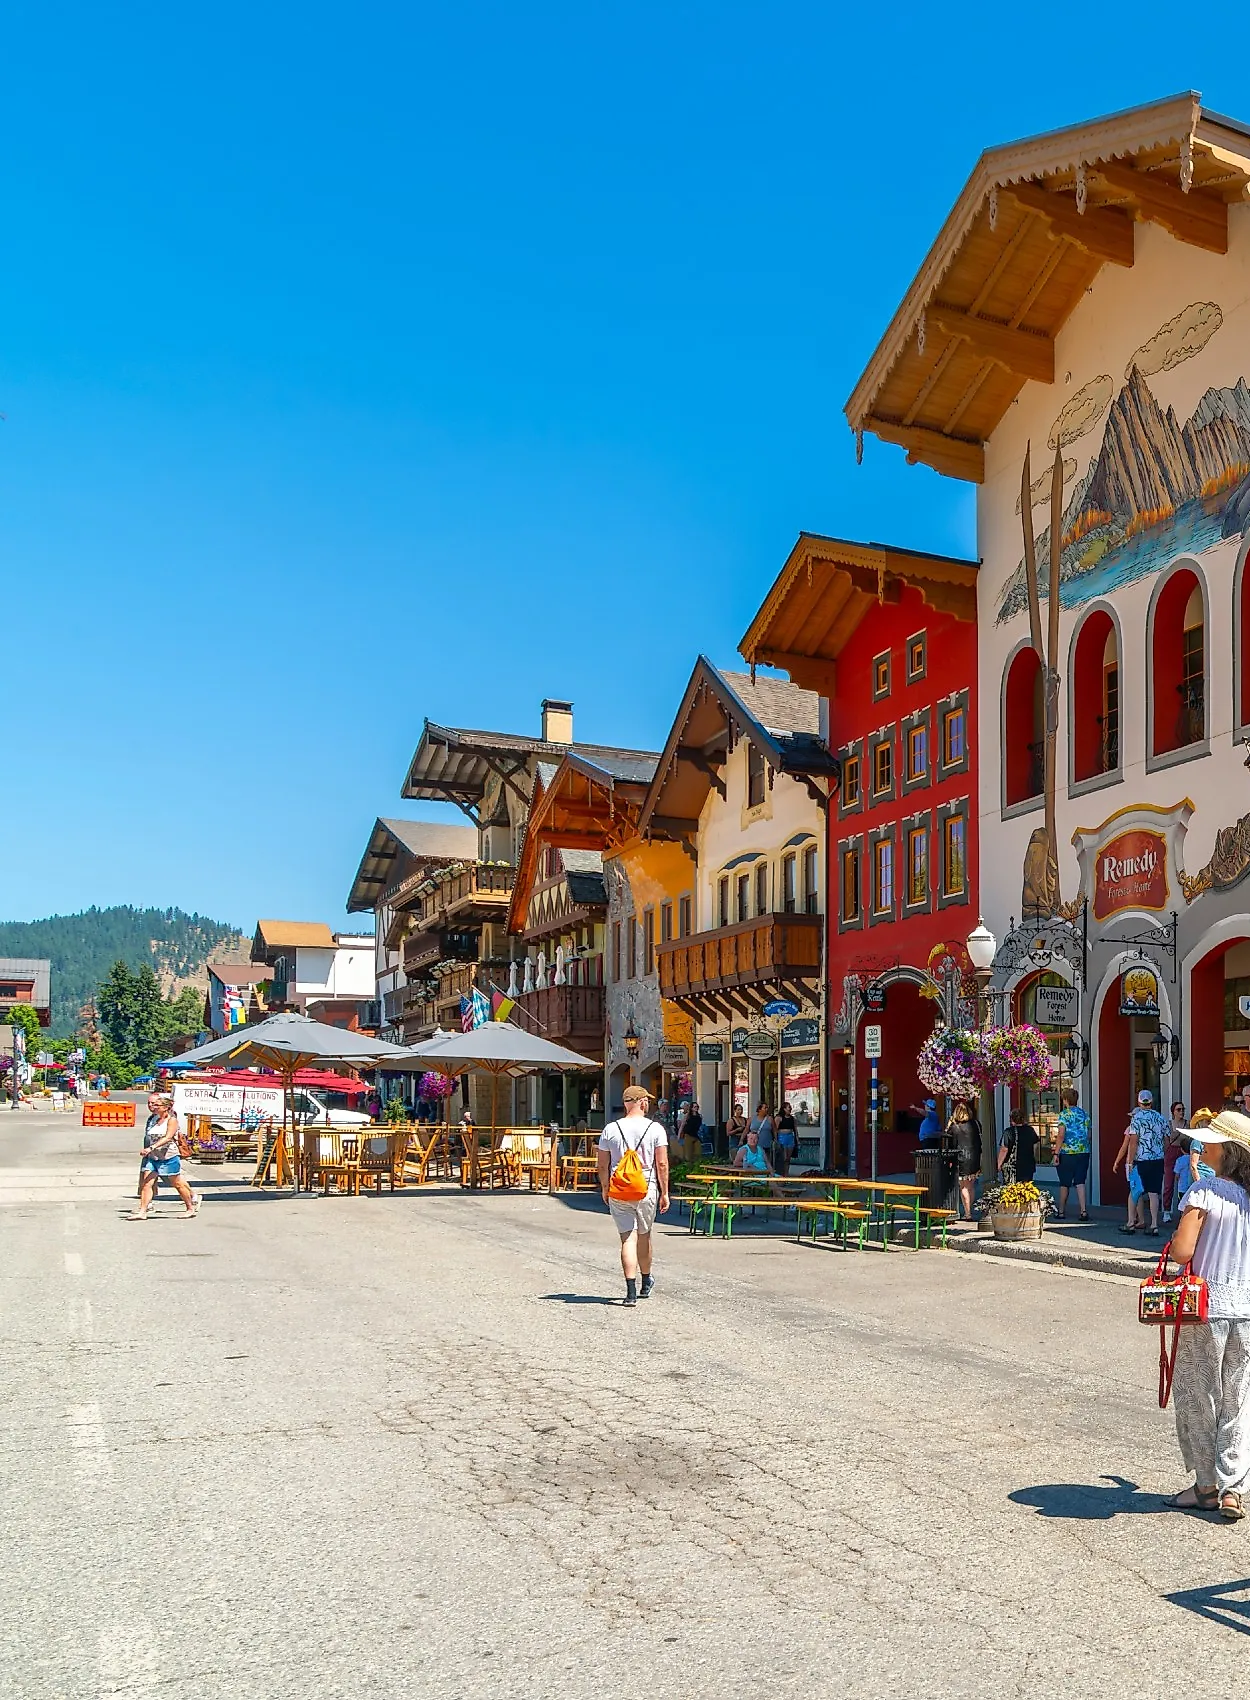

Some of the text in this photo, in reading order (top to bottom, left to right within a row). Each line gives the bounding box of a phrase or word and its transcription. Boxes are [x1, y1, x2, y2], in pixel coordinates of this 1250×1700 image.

[1104, 849, 1157, 882] Remedy
[1039, 988, 1075, 1004] Remedy
[1047, 1001, 1067, 1010] Forest
[1048, 1014, 1066, 1022] Home
[868, 1028, 878, 1036] 30
[184, 1091, 276, 1100] CENTRA AIR SLUTIONS
